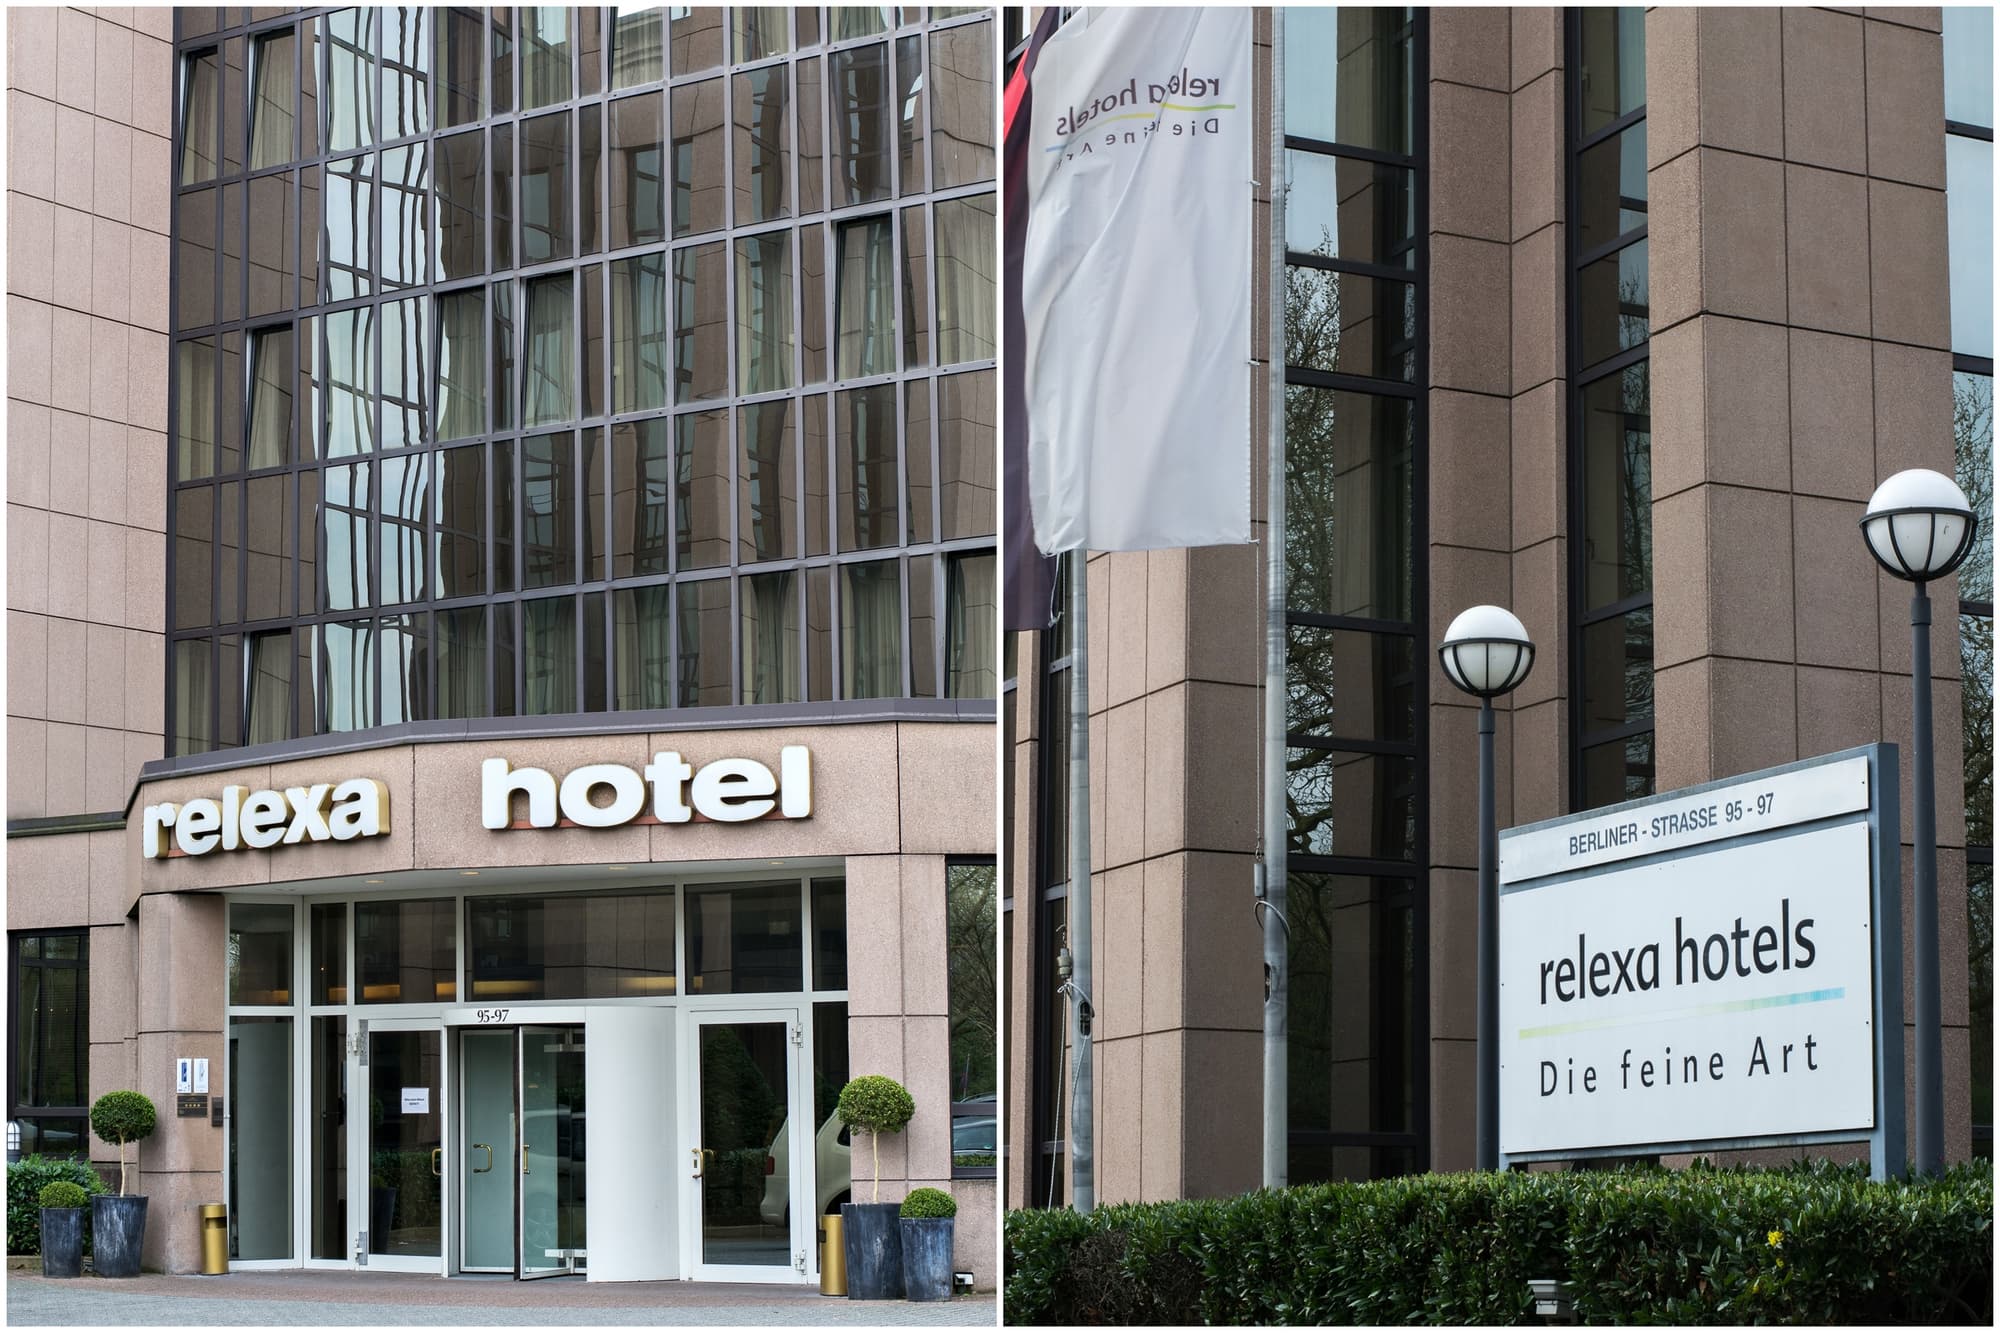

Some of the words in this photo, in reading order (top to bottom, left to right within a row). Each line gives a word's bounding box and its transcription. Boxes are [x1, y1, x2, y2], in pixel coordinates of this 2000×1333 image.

[143, 778, 391, 859] relexa
[482, 745, 814, 830] hotel
[1569, 822, 1638, 856] BERLINER
[1651, 805, 1718, 839] STRASSE
[1725, 800, 1743, 823] 95
[1757, 792, 1774, 816] 97
[1539, 933, 1660, 1005] relexa
[1675, 897, 1817, 986] hotels
[477, 1009, 510, 1023] 95-97
[1540, 1057, 1597, 1098] Die
[1620, 1046, 1725, 1090] feine
[1747, 1033, 1818, 1078] Art
